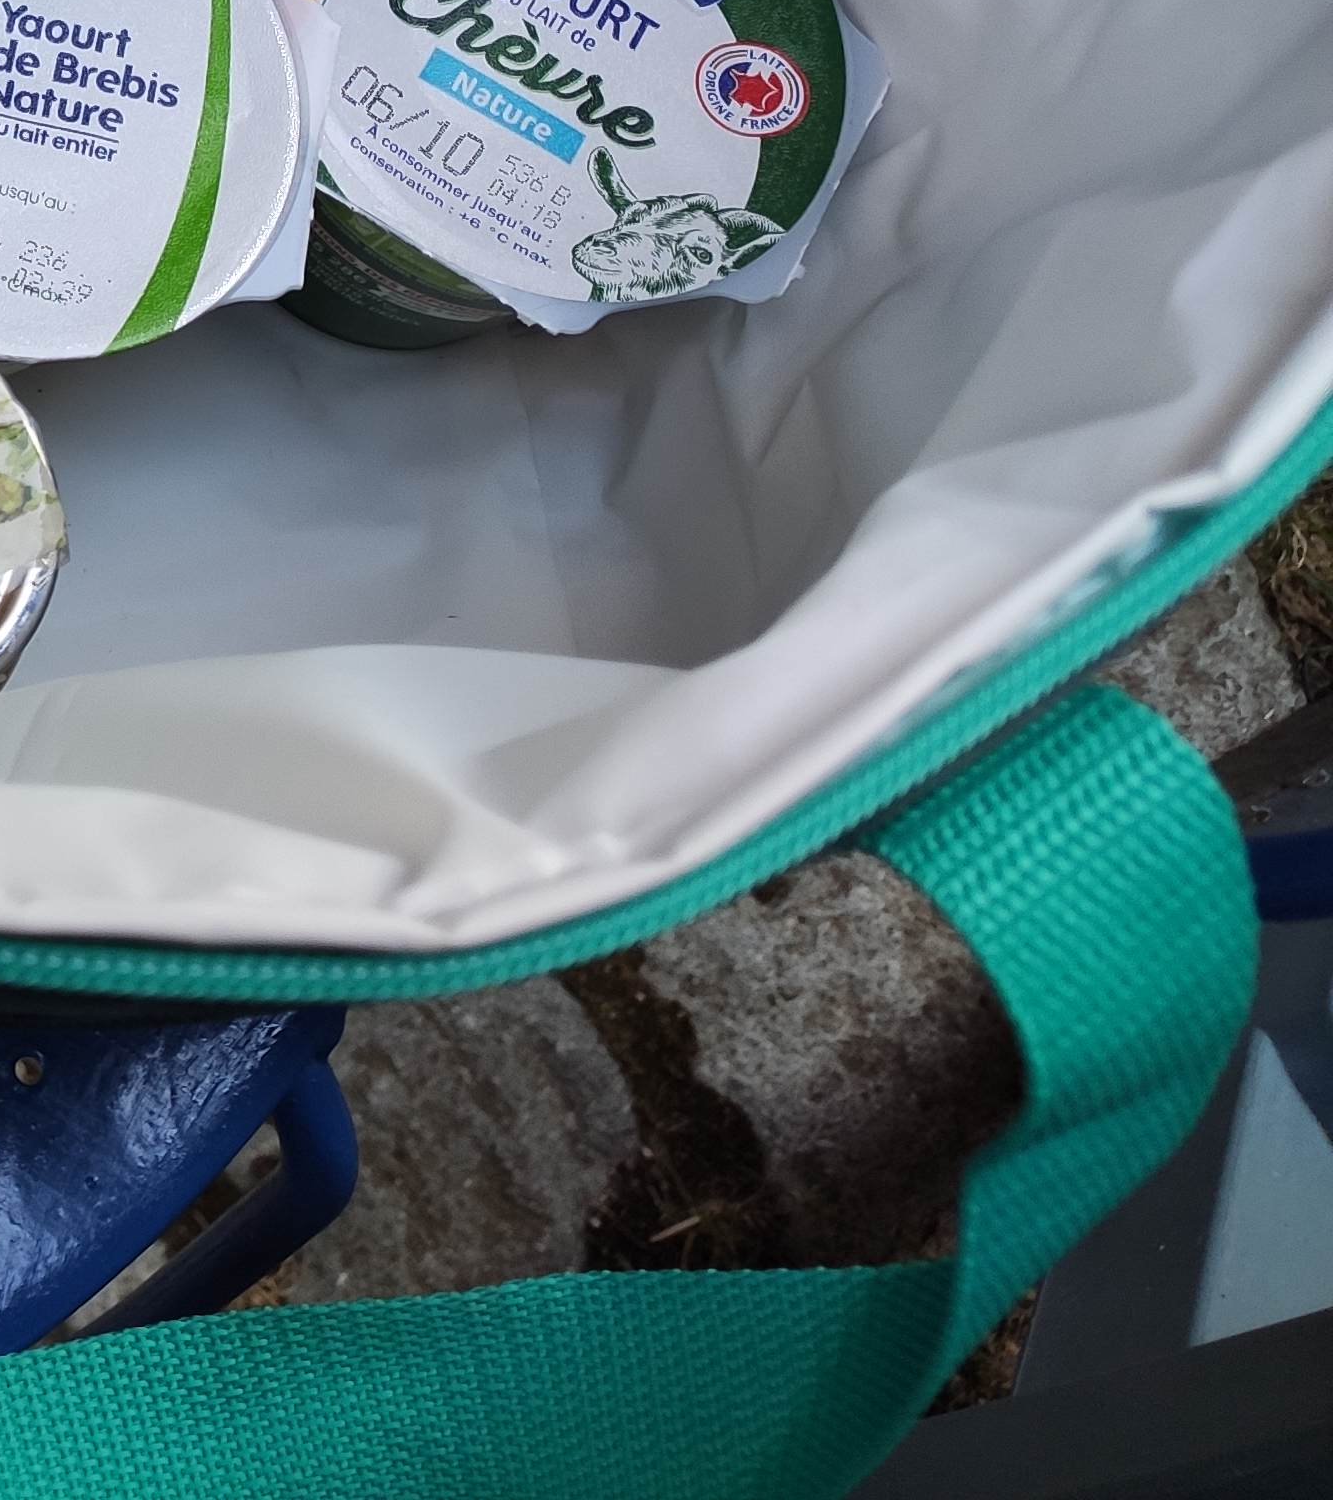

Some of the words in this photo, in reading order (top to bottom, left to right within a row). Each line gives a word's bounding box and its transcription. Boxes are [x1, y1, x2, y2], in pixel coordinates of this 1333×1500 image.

[2, 0, 131, 58] Yaourt
[570, 29, 596, 52] de
[52, 51, 180, 107] Brebis
[749, 49, 786, 70] LAIT
[341, 66, 486, 177] 06/10
[451, 69, 554, 142] Nature
[705, 70, 734, 122] ORIGINE
[740, 105, 795, 130] FRANCE
[13, 123, 49, 146] lait
[51, 135, 118, 162] entier
[382, 137, 470, 202] consommer
[470, 196, 543, 244] jusqu'au
[498, 153, 549, 193] 536
[349, 135, 445, 209] Conservation
[459, 211, 482, 230] +6
[513, 241, 553, 269] max.
[18, 240, 70, 272] 236
